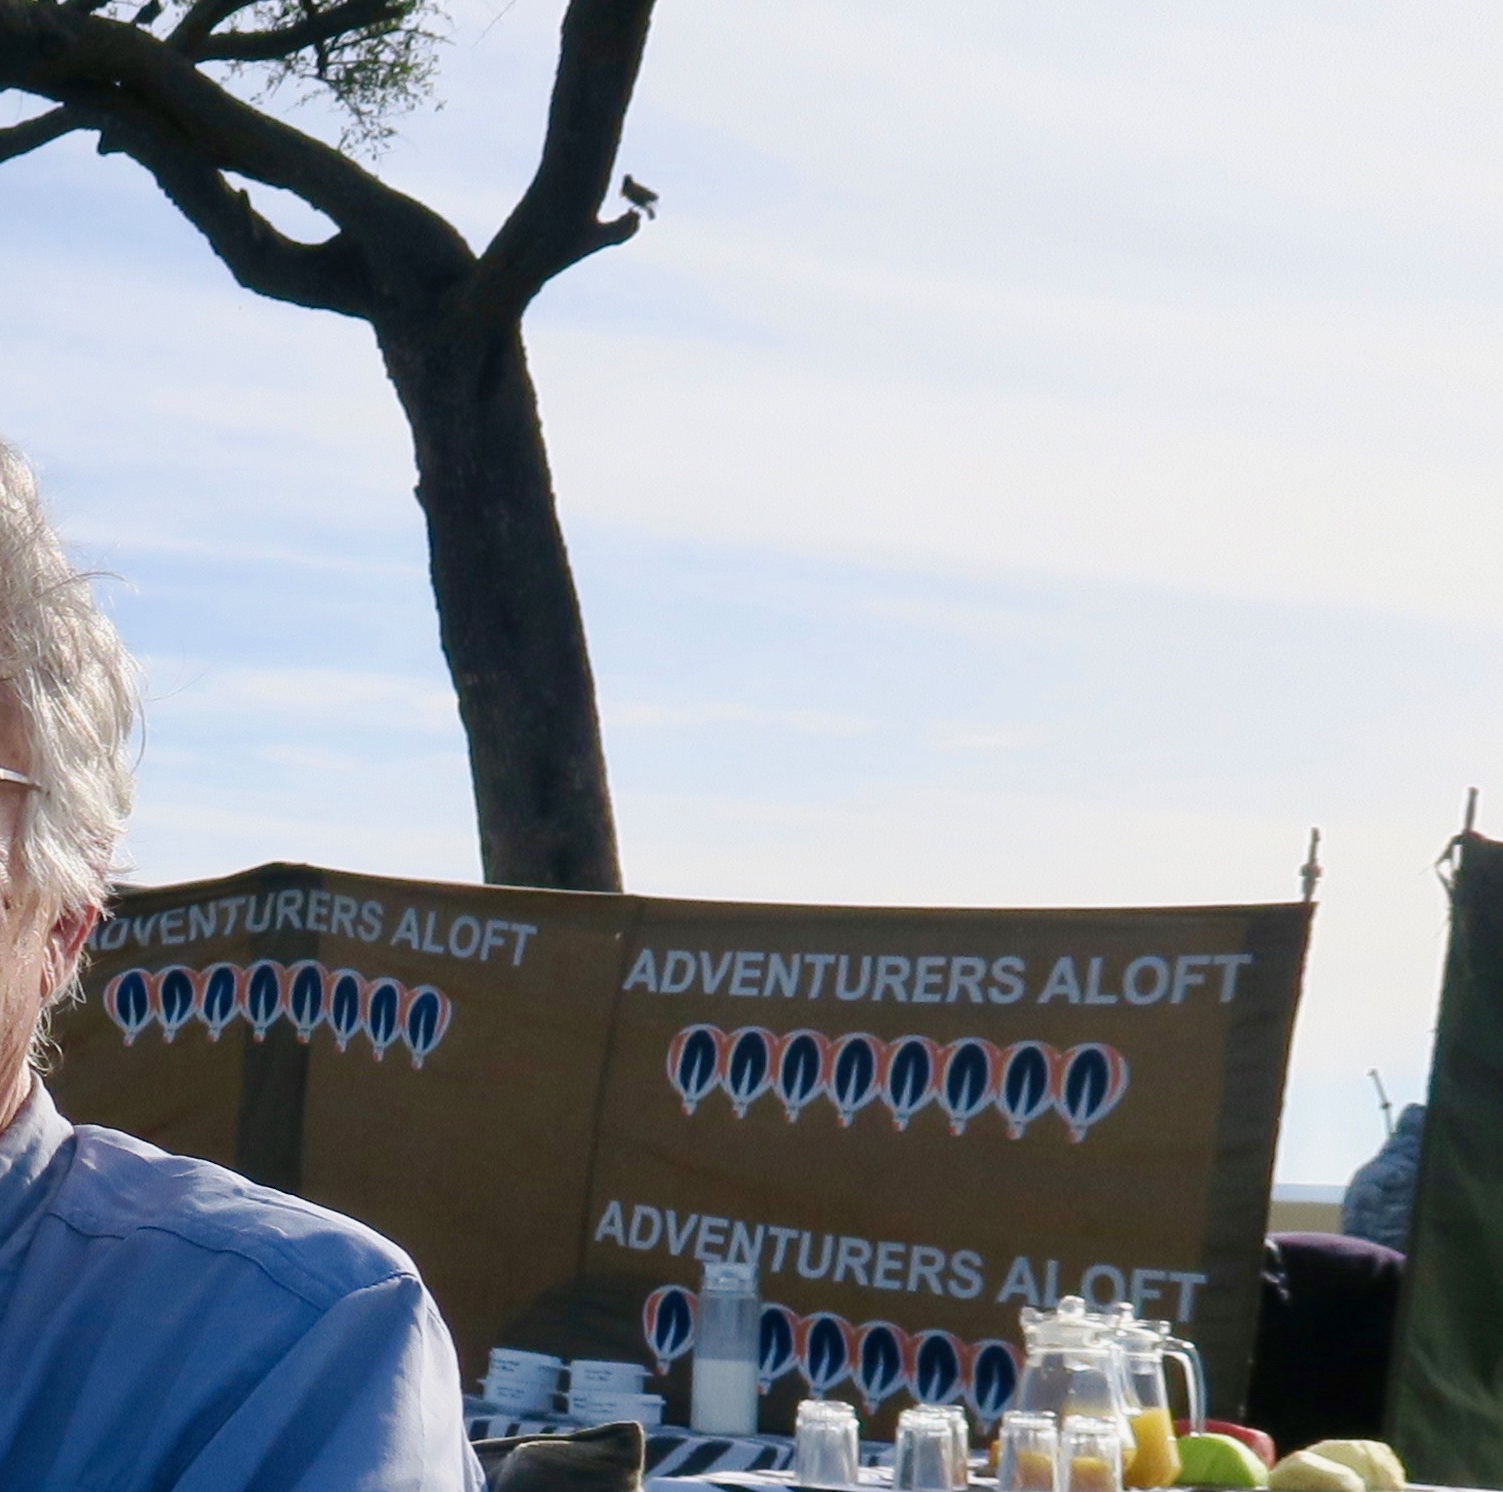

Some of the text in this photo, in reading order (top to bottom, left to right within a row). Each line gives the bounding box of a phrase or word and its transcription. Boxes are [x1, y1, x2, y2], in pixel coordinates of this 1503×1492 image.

[88, 888, 537, 968] DVENTURERS ALOFT
[622, 948, 1252, 1005] ADVENTURERS ALOFT
[595, 1199, 984, 1300] ADVENTURERS
